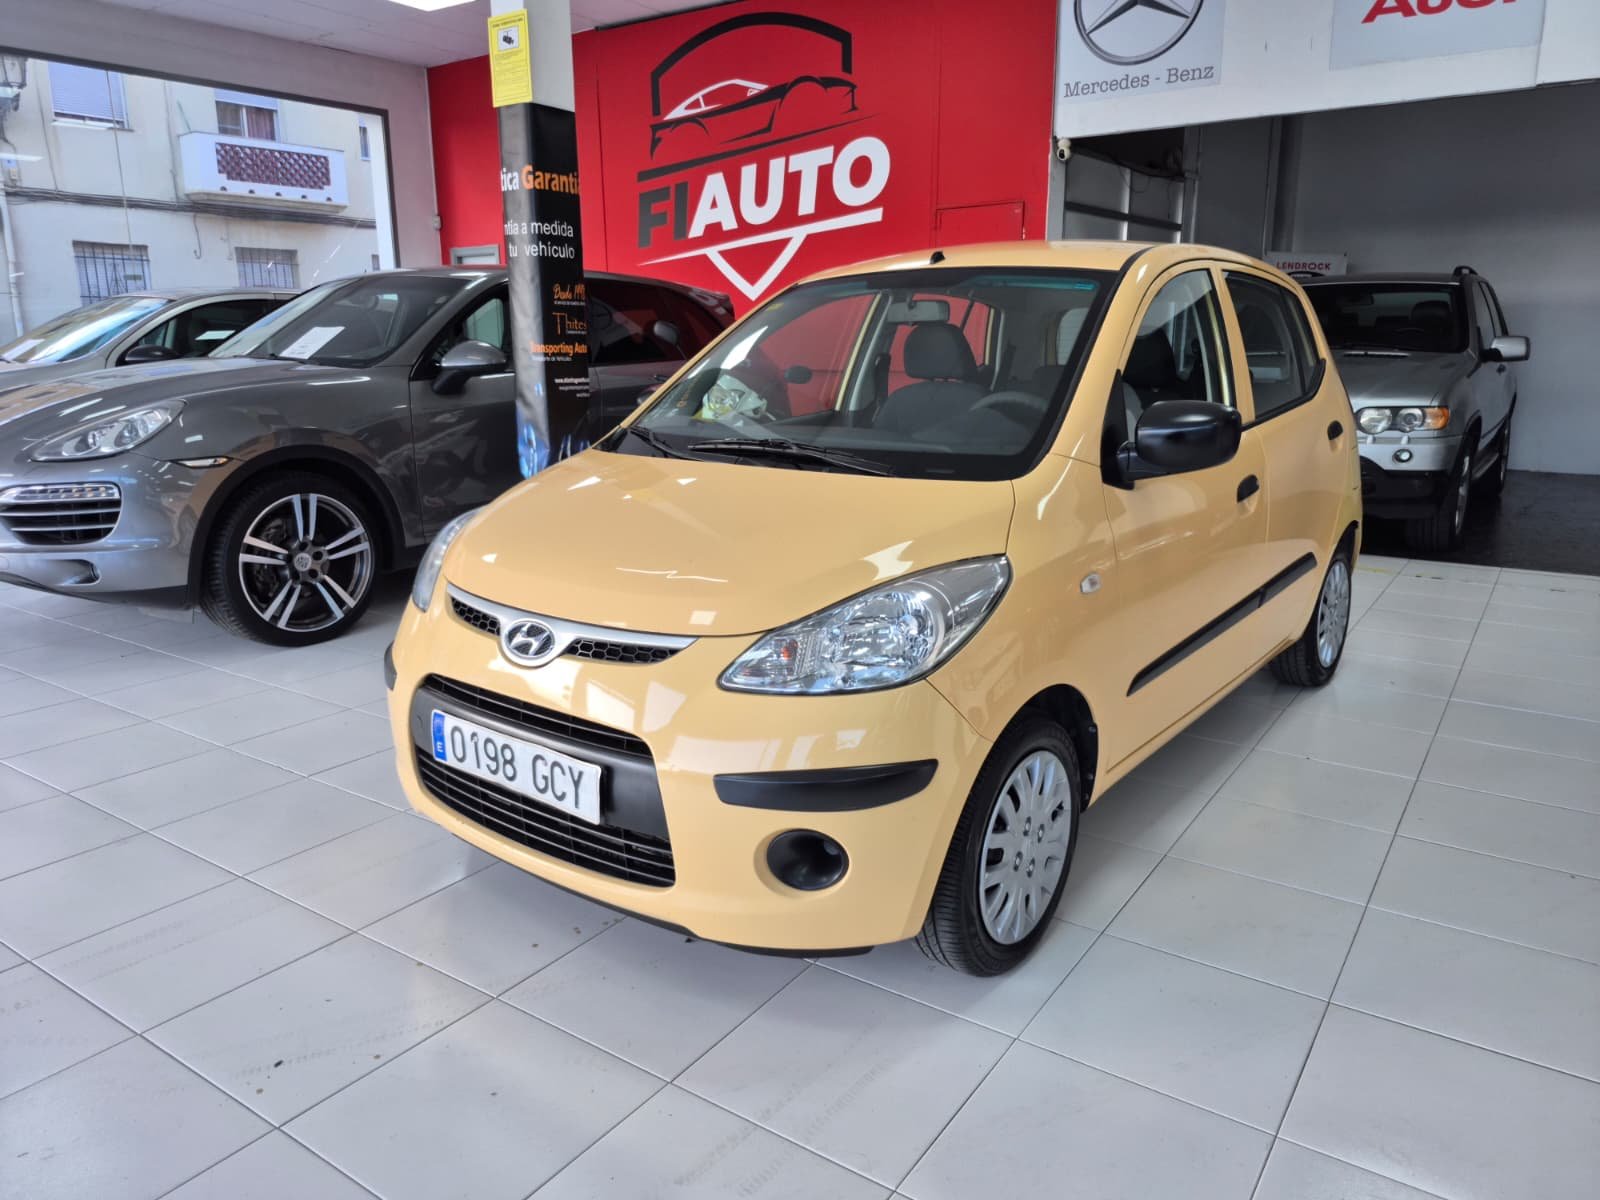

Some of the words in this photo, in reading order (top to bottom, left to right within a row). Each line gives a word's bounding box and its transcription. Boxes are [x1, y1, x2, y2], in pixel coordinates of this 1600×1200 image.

[1063, 74, 1150, 98] Mercedes
[1166, 65, 1214, 84] Benz
[637, 136, 890, 249] FIAUTO
[530, 220, 573, 238] medida
[509, 241, 518, 258] tu
[1275, 261, 1331, 271] LENDROCK
[450, 725, 518, 783] 0198
[531, 753, 584, 809] GCY
